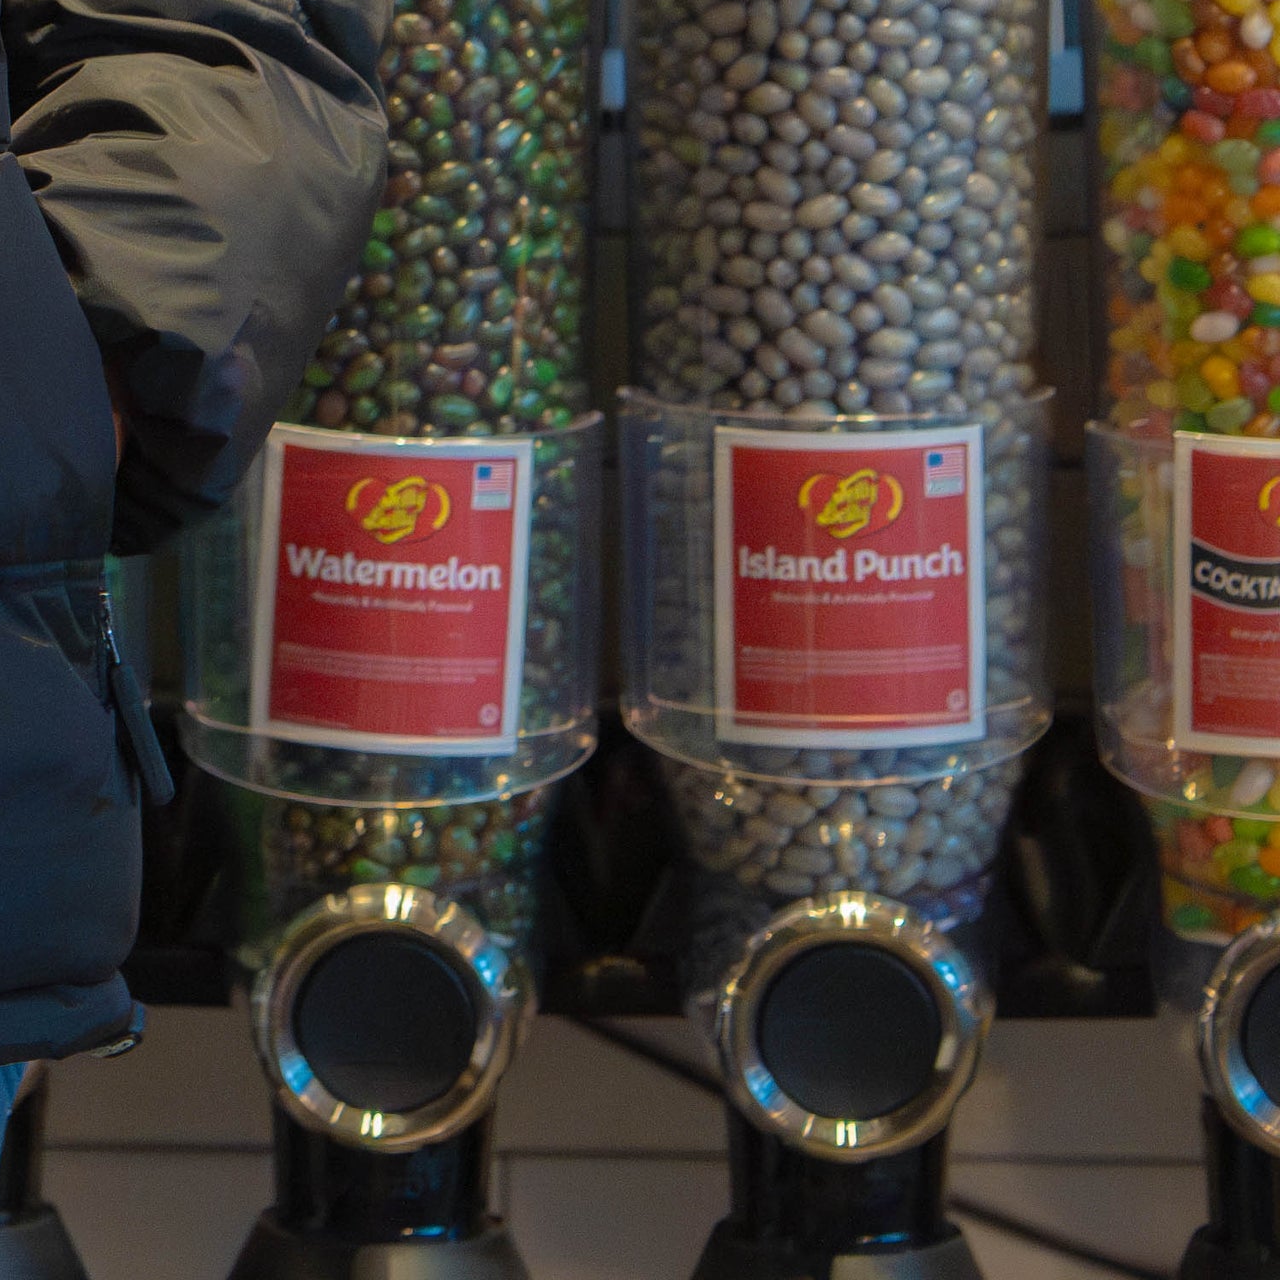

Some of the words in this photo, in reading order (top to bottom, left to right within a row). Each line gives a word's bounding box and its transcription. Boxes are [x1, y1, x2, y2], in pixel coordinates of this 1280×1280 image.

[286, 543, 501, 590] Watermelon
[739, 545, 848, 583] Island
[854, 543, 963, 582] Punch
